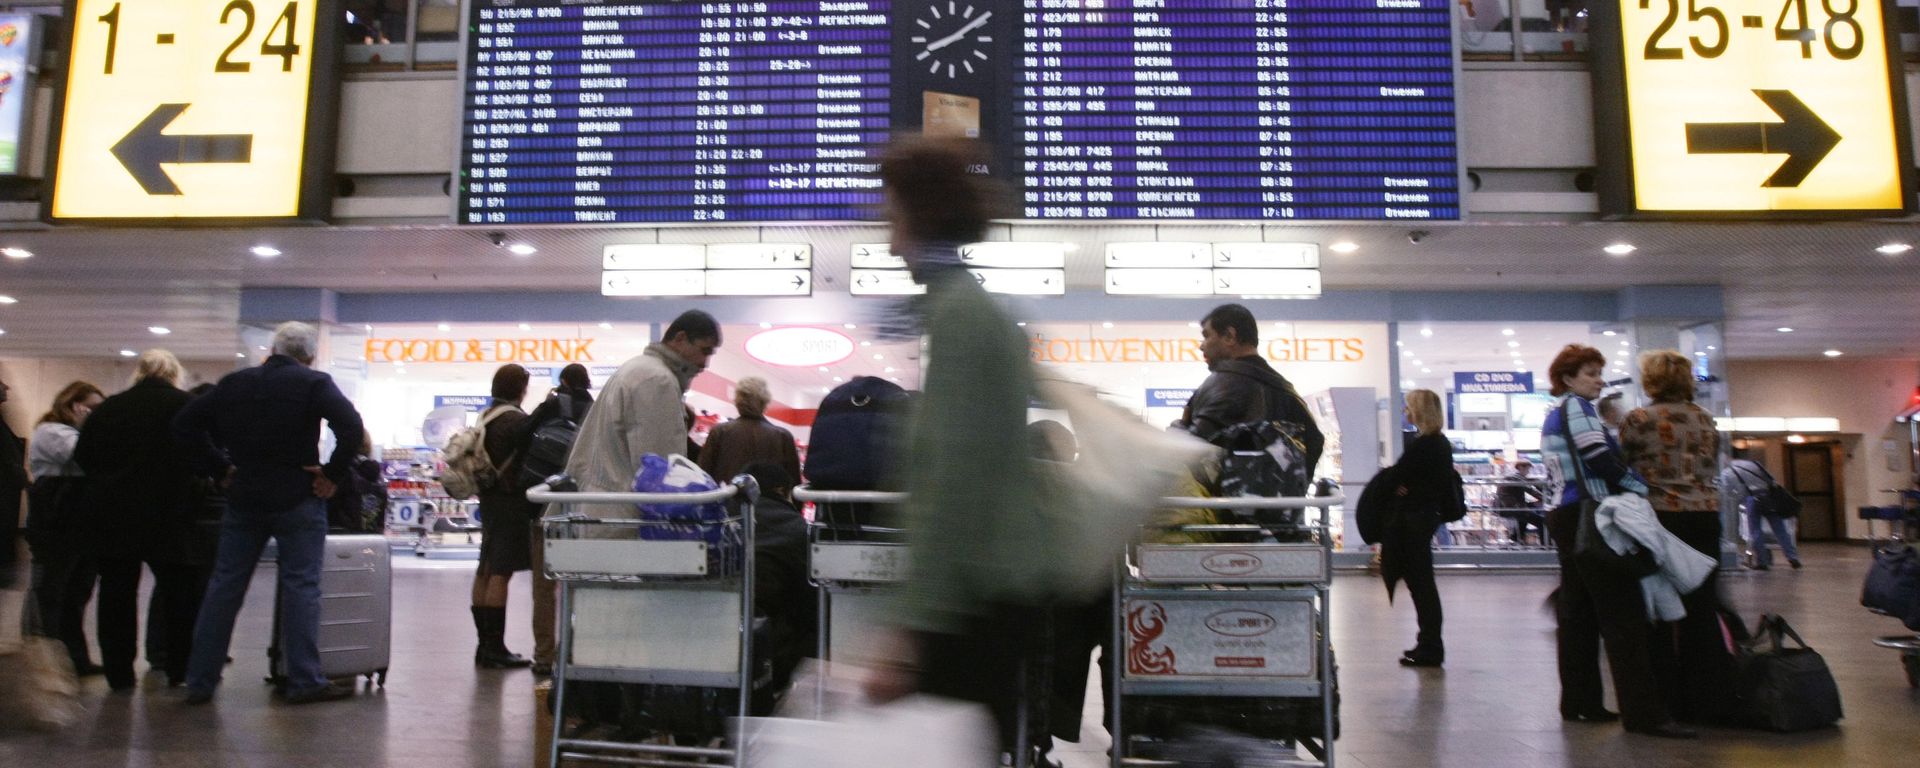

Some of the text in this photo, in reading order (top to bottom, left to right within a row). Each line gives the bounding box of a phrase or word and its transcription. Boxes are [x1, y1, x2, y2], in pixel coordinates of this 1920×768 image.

[480, 9, 494, 19] SU
[583, 5, 644, 17] КОПЕНГАГЕН
[1133, 12, 1159, 23] РИГА
[1255, 12, 1288, 23] 22:45
[818, 14, 887, 26] РЕГИСТРАЦИЯ
[98, 2, 121, 75] 1
[214, 0, 300, 73] 24
[734, 31, 766, 42] 21:00
[1024, 27, 1038, 38] SU
[698, 46, 730, 58] 20:10
[1024, 56, 1289, 67] SU ЕРЕВАН 23:55
[1042, 71, 1062, 82] 212
[697, 90, 729, 101] 20:40
[1085, 85, 1105, 96] 417
[1134, 86, 1192, 96] АМСТЕРДАМ
[474, 109, 488, 120] SU
[578, 106, 633, 118] АМСТЕРДАМ
[696, 119, 728, 131] 21:00
[1024, 116, 1038, 127] TK
[472, 138, 486, 149] SU
[695, 134, 728, 146] 21:15
[1024, 131, 1039, 142] SU
[1135, 130, 1175, 142] ЕРЕВАН
[471, 153, 485, 164] SU
[695, 149, 727, 160] 21:20
[731, 148, 763, 160] 22:20
[1024, 146, 1038, 156] SU
[1135, 146, 1162, 156] РИГА
[471, 167, 485, 178] SU
[694, 164, 727, 175] 21:35
[1259, 161, 1293, 172] 07:35
[470, 182, 484, 193] SU
[1024, 176, 1039, 187] SU
[469, 197, 483, 208] SU
[694, 194, 726, 205] 22:25
[1024, 191, 1039, 202] SU
[1136, 191, 1201, 202] КОПЕНГАГЕН
[468, 212, 482, 223] SU
[693, 209, 726, 220] 22:40
[1024, 206, 1039, 218] SU
[1137, 206, 1195, 218] ХЕЛЬСИНКИ
[1262, 207, 1294, 218] 17:10
[364, 338, 594, 363] FOOD & DRINK
[1266, 337, 1365, 363] GIFTS
[1461, 383, 1527, 393] MULTIMEDIA
